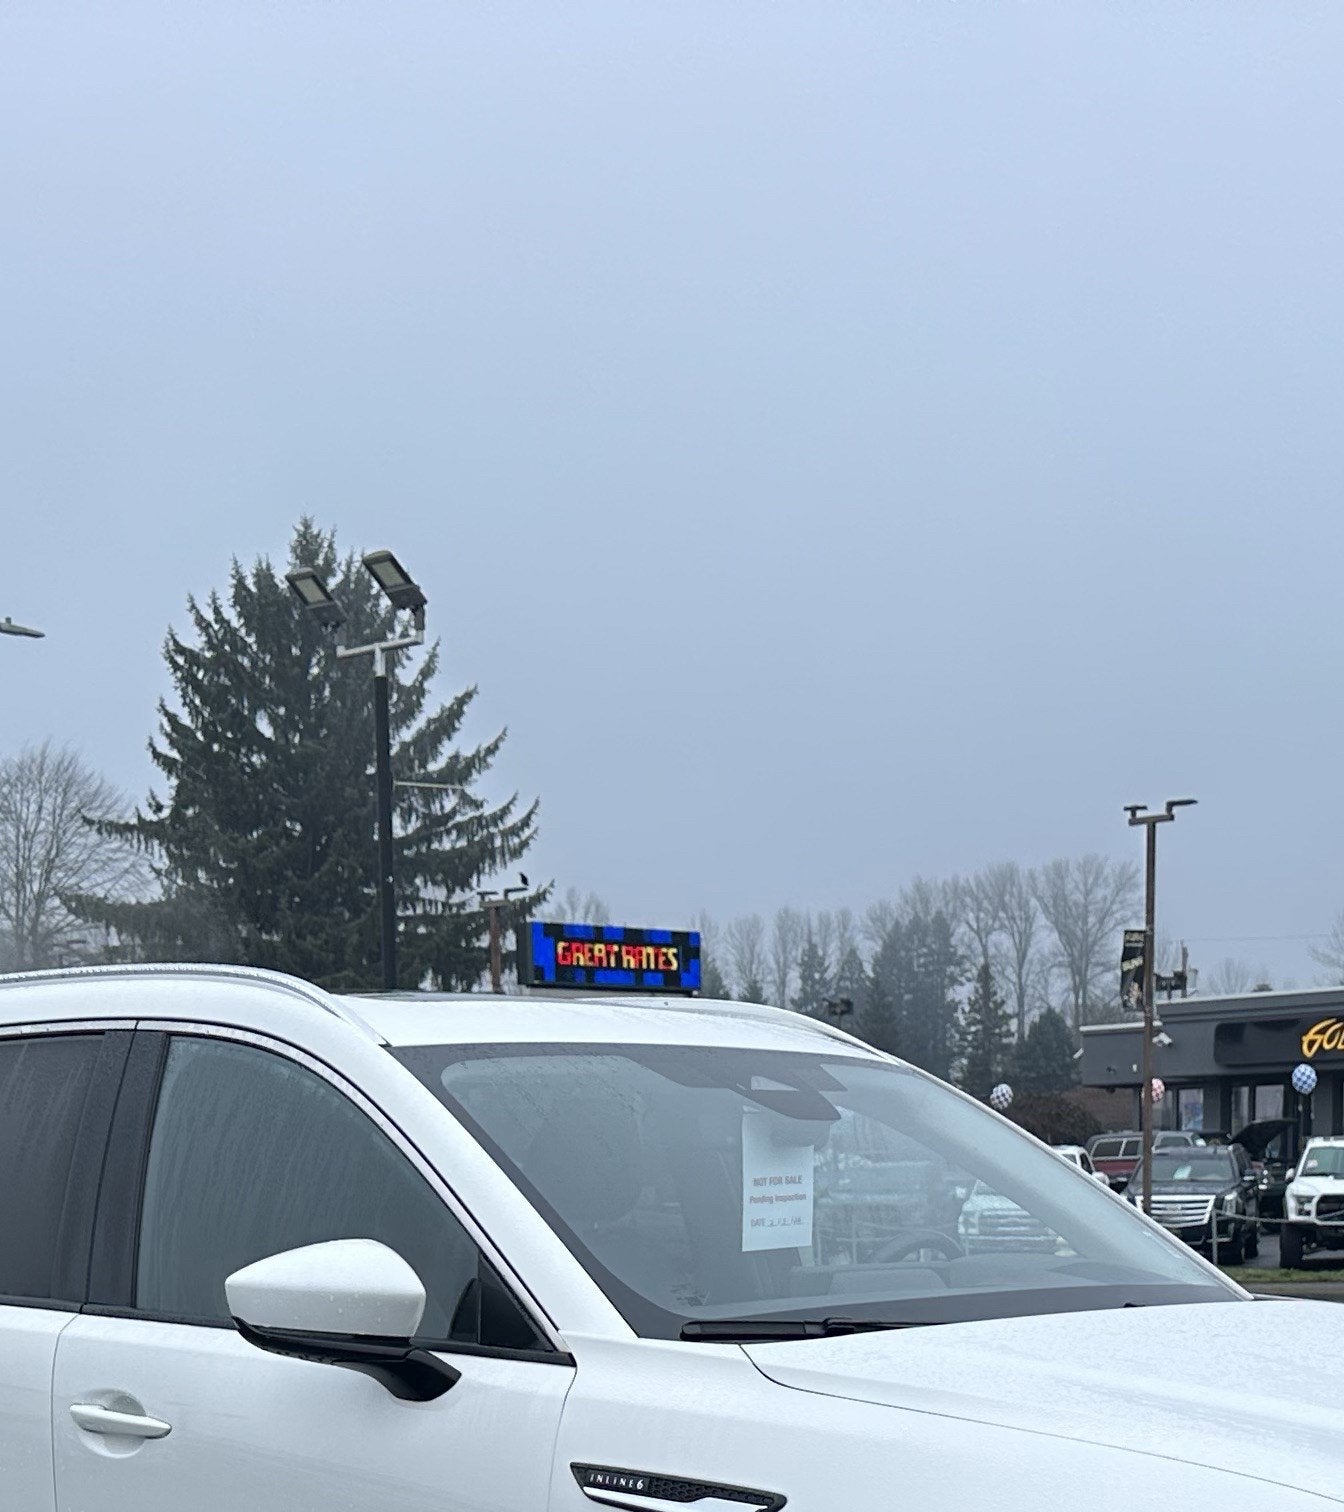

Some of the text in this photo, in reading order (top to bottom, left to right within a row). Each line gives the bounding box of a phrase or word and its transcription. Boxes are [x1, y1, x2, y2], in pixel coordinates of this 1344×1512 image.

[557, 941, 678, 971] GREAT RATES
[753, 1175, 802, 1186] NOT FOR SALE
